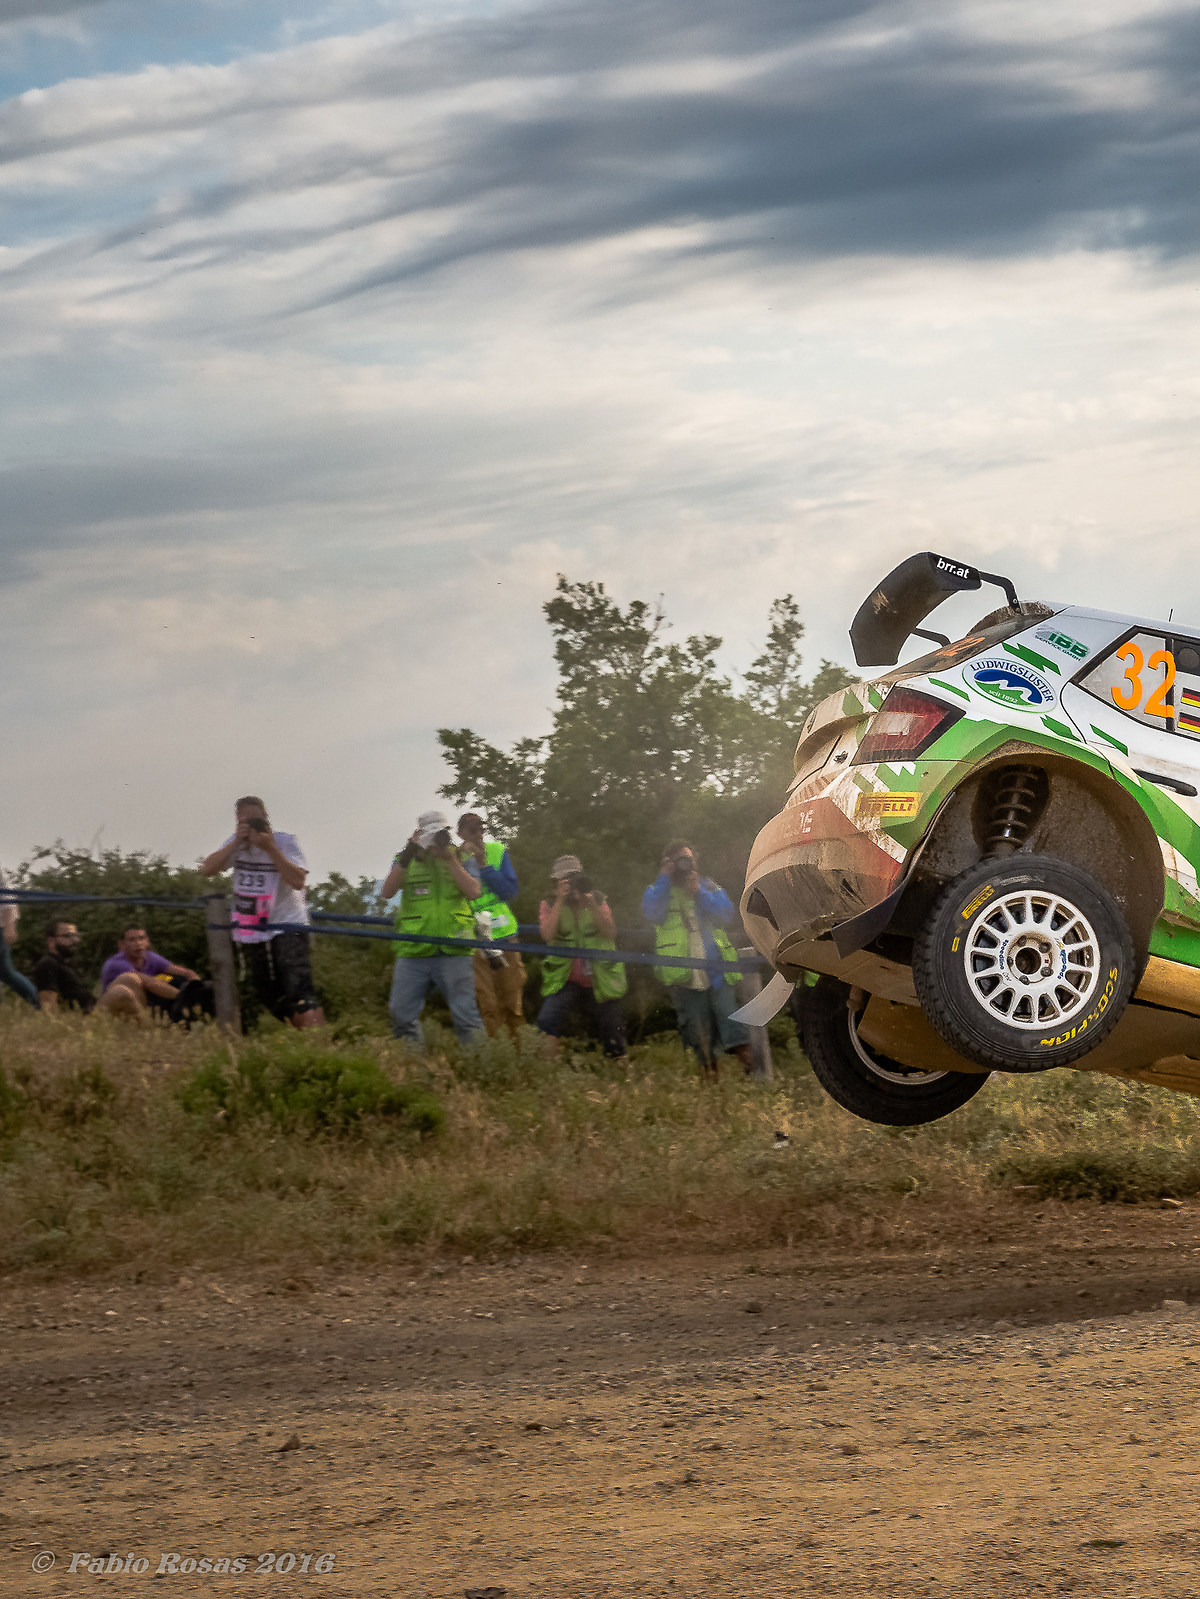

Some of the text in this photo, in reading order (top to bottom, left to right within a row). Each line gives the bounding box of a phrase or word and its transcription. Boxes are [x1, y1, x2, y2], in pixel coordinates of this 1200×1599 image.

[936, 557, 970, 580] brr.at
[970, 660, 1054, 702] LUDWIGSLUSTER
[1111, 642, 1177, 718] 32
